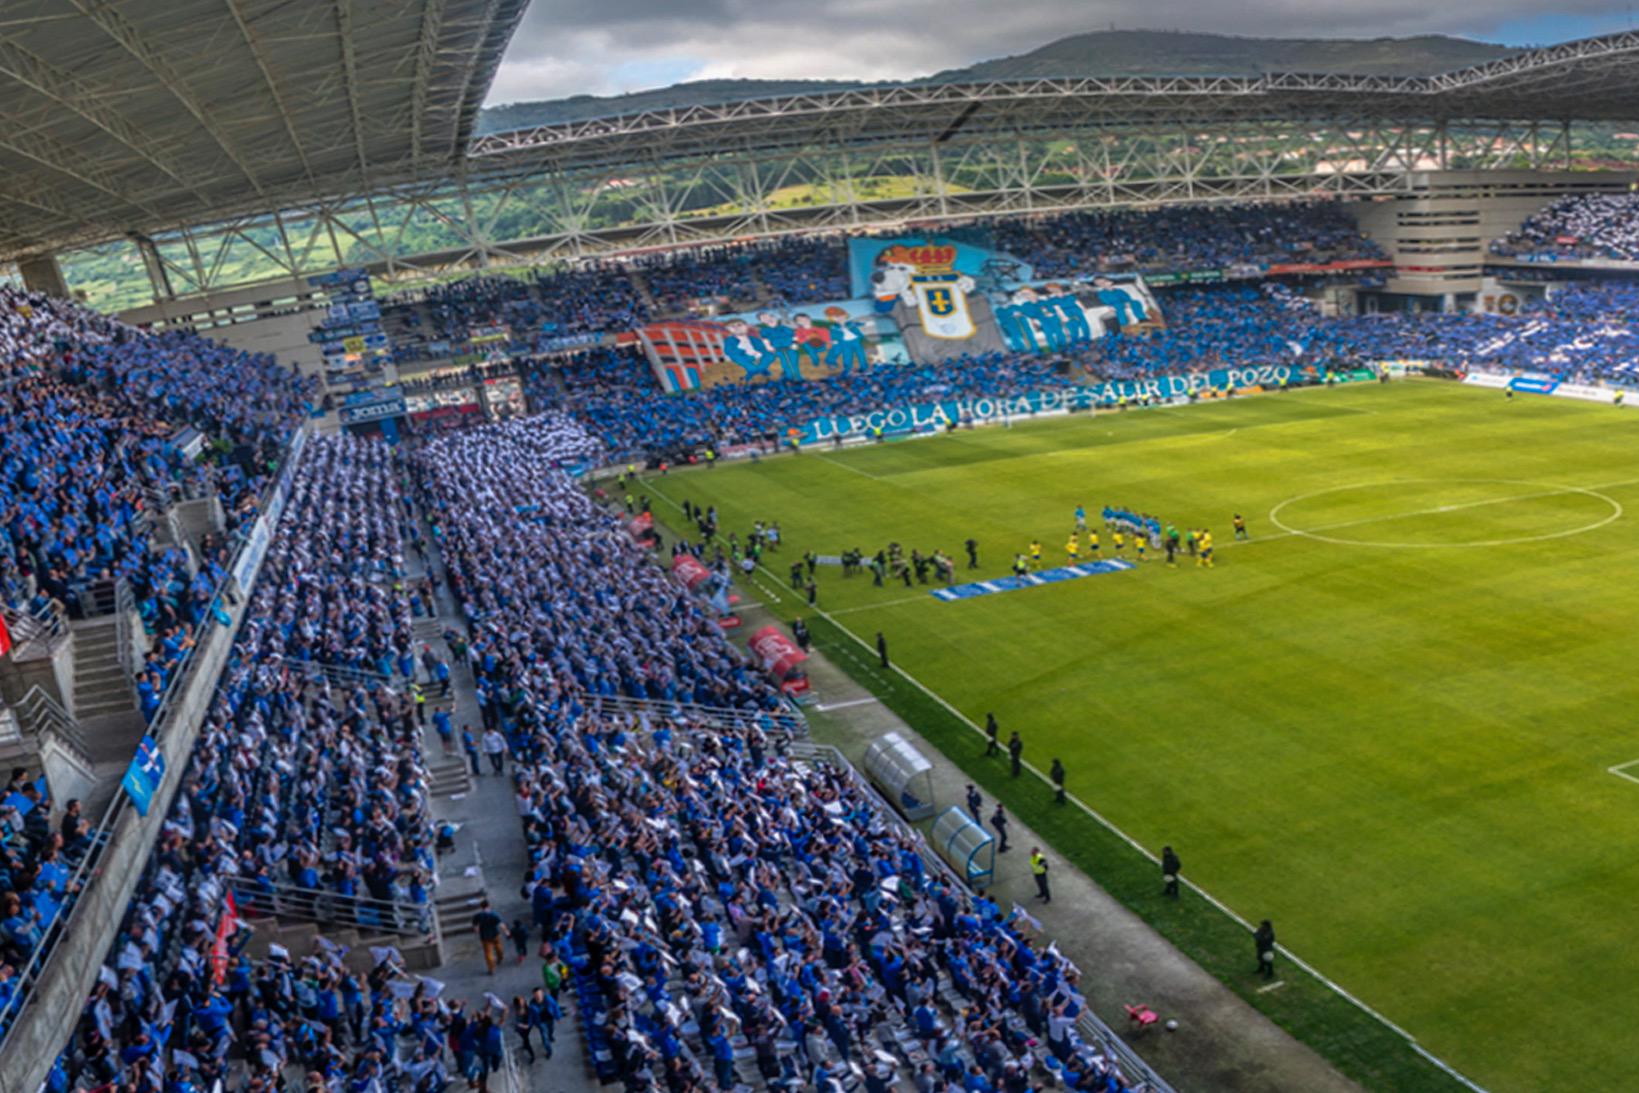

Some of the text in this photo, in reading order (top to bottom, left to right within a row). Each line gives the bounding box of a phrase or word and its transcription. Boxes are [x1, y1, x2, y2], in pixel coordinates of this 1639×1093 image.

[910, 401, 948, 427] LA
[956, 394, 1033, 420] HORA
[1084, 379, 1163, 407] SALIR
[1168, 369, 1213, 397] DEL
[1227, 365, 1291, 391] POZO
